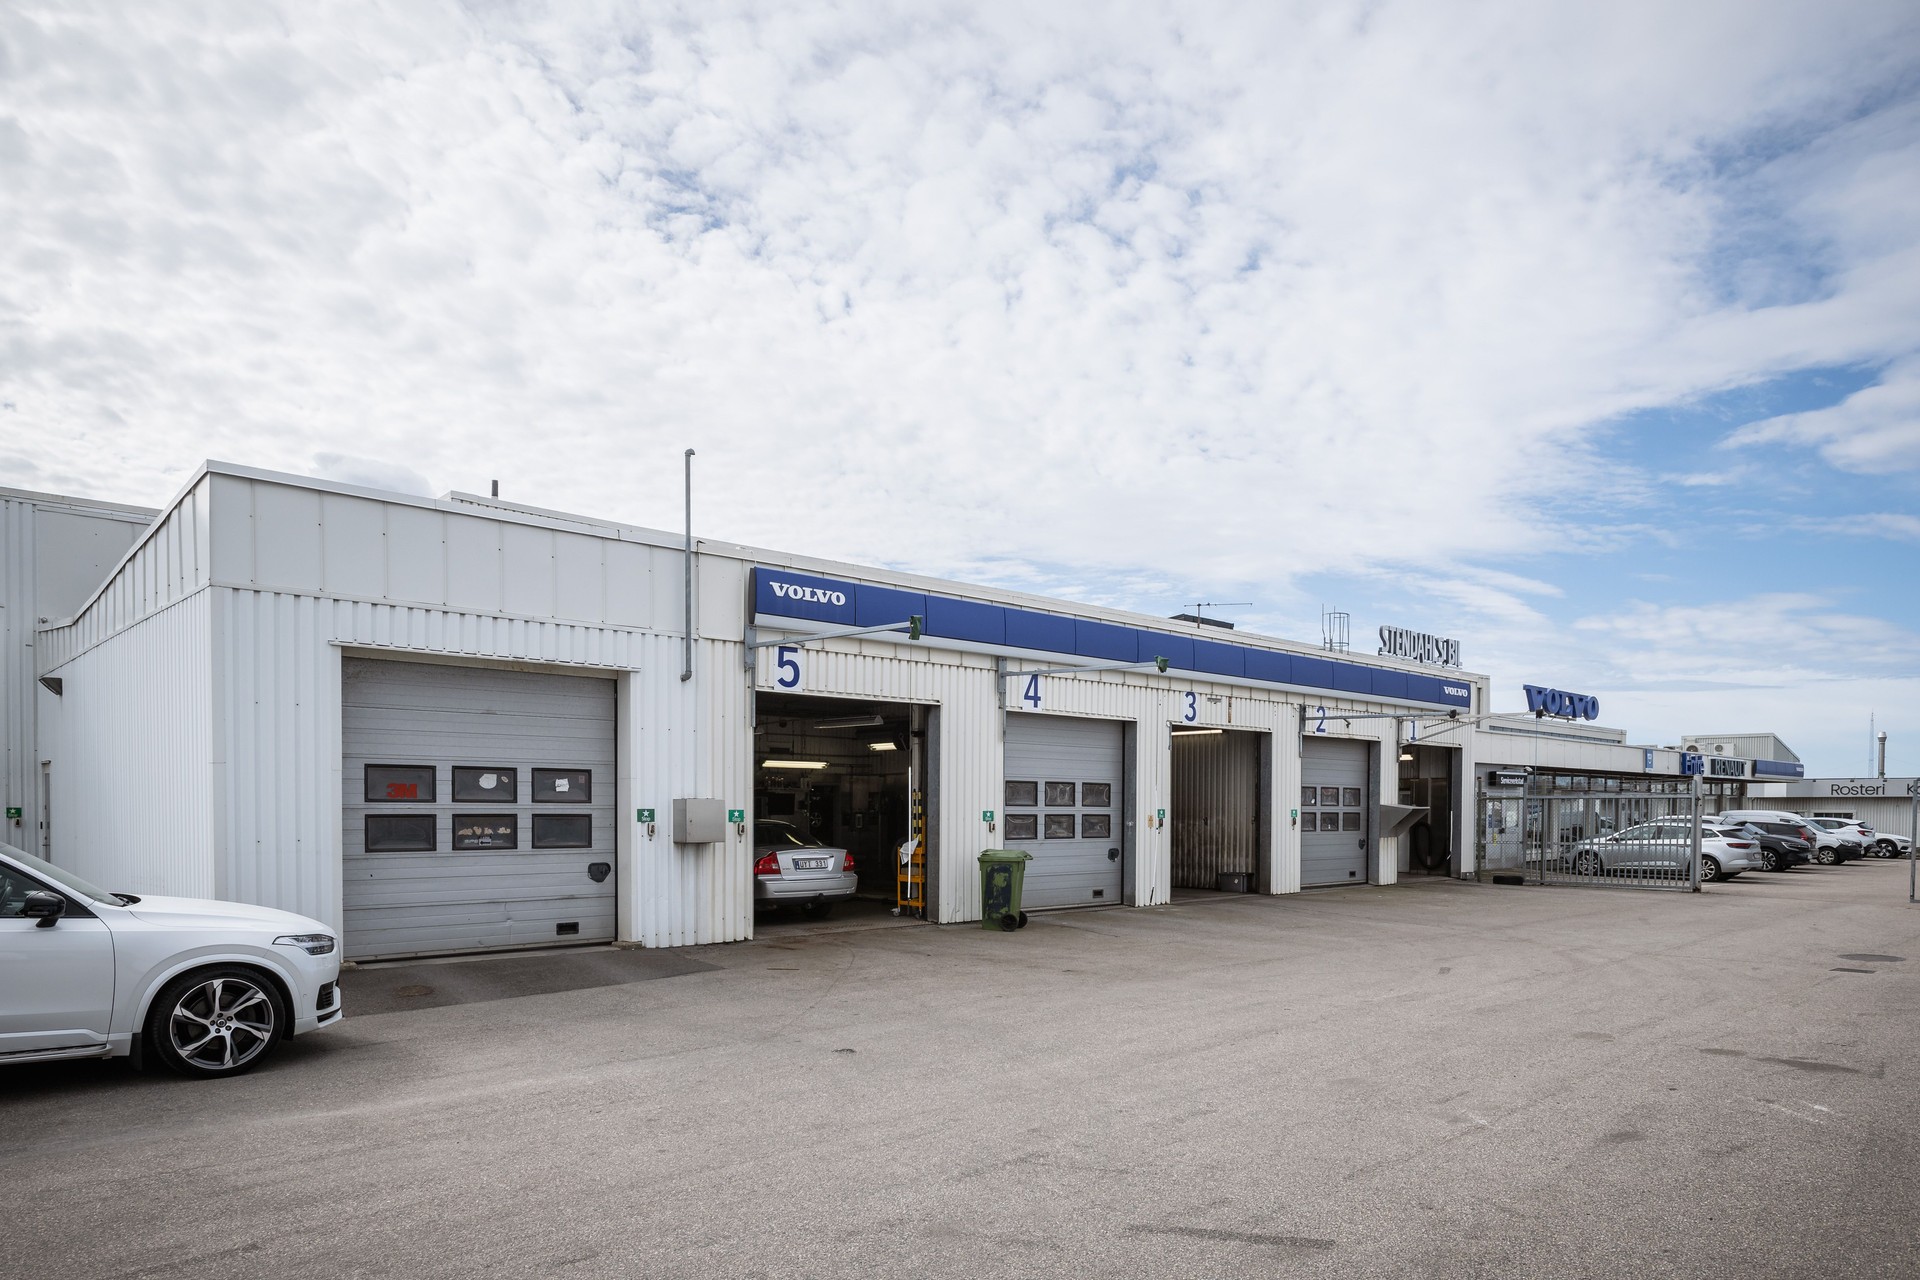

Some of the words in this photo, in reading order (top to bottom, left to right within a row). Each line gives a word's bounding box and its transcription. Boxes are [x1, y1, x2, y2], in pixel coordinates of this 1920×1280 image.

[769, 581, 846, 606] VOLVO
[1379, 625, 1447, 664] STENDAHLS
[1447, 639, 1463, 667] BIL
[777, 646, 800, 688] 5
[1024, 673, 1041, 708] 4
[1443, 686, 1468, 697] VOLVO
[1522, 684, 1599, 721] VOLVO
[1185, 691, 1196, 722] 3
[1316, 706, 1326, 733] 2
[1410, 720, 1417, 741] 1
[1715, 759, 1746, 777] RENAULT
[386, 782, 418, 799] 3M
[1831, 783, 1885, 796] Rosteri
